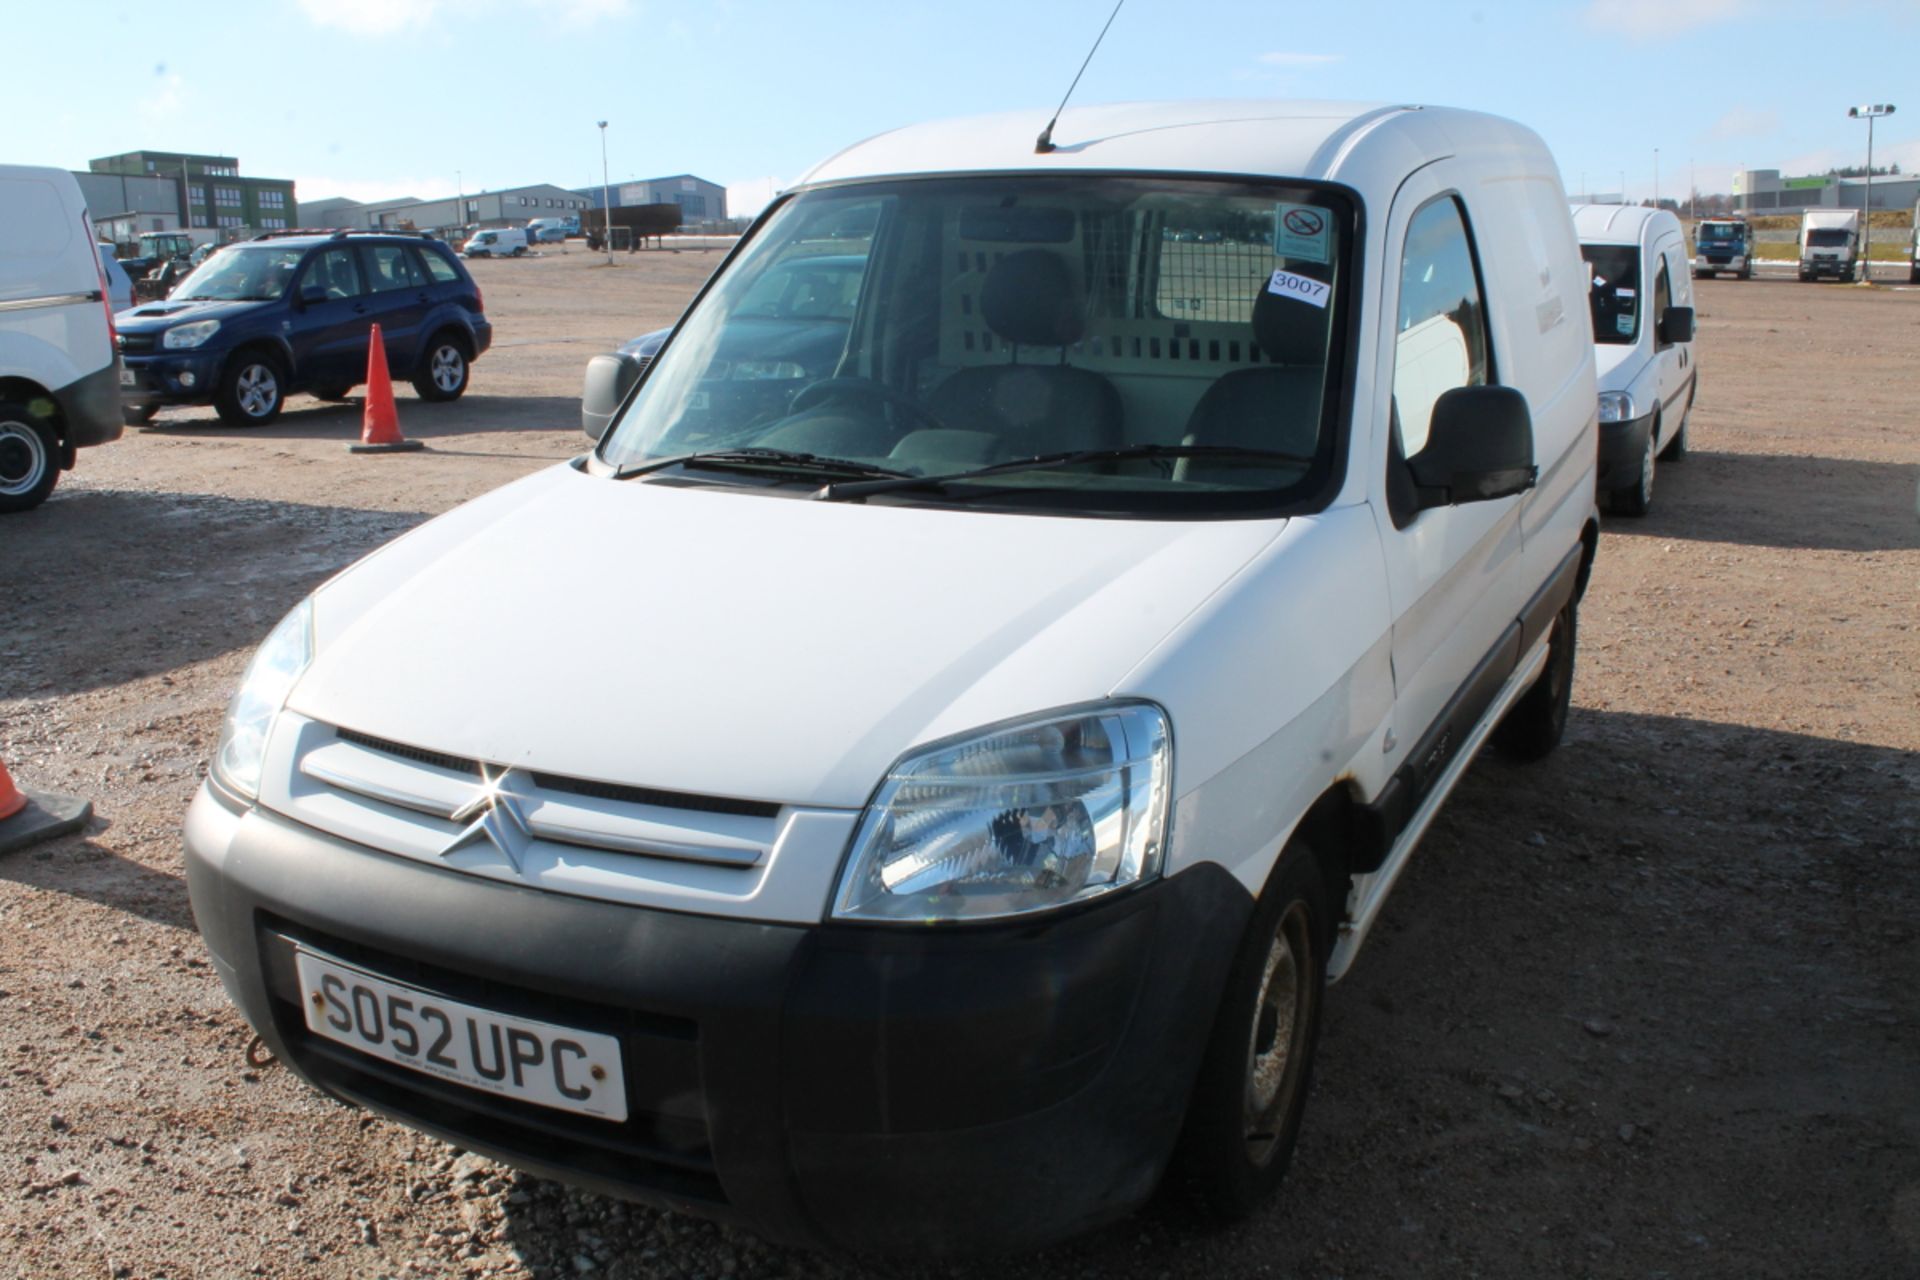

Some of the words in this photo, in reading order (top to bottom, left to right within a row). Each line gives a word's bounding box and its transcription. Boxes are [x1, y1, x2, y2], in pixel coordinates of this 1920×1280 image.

[1274, 274, 1324, 296] 3007
[321, 973, 457, 1070] SO52
[466, 1017, 592, 1101] UPC
